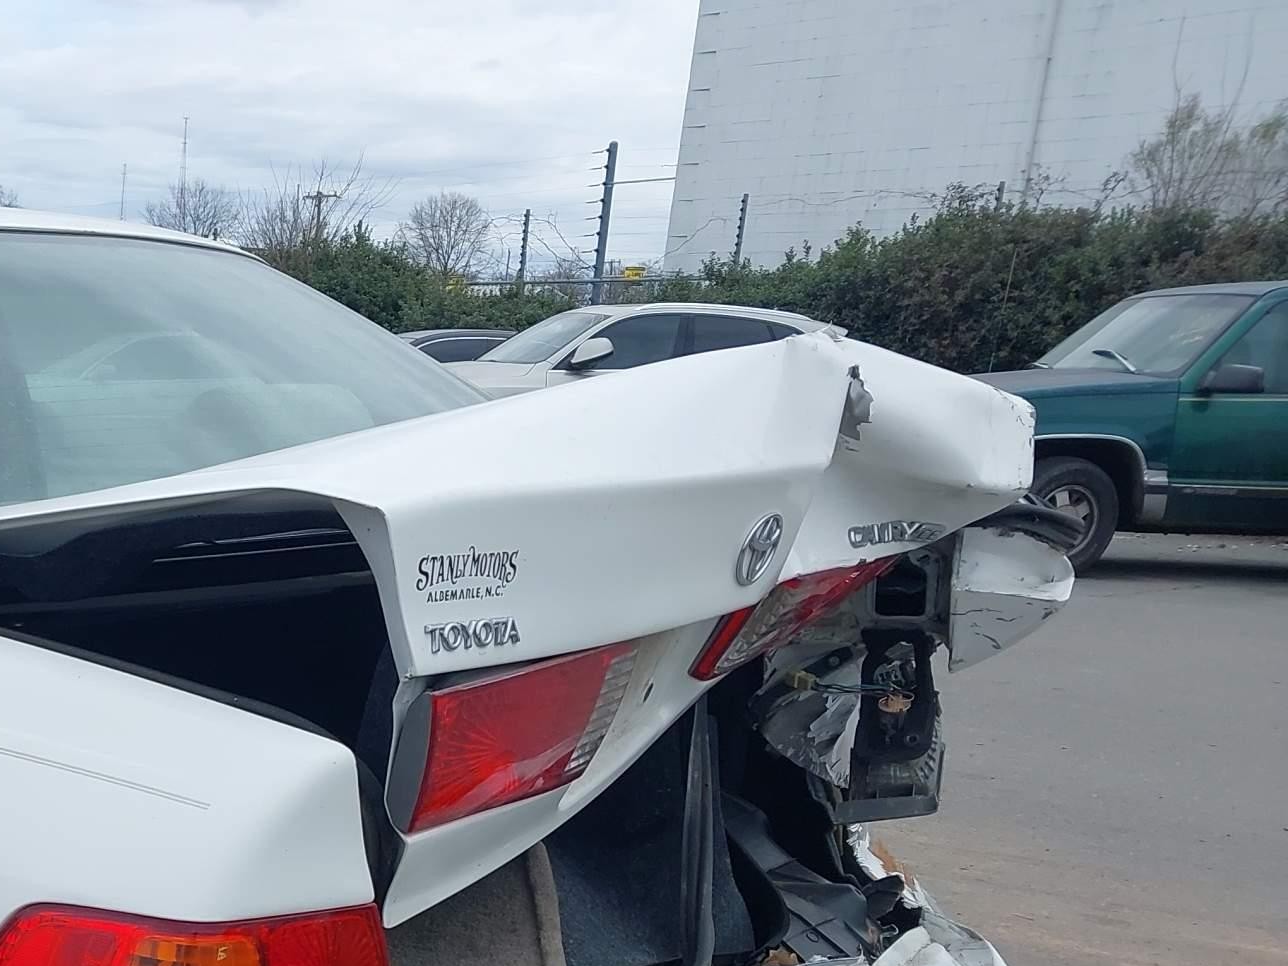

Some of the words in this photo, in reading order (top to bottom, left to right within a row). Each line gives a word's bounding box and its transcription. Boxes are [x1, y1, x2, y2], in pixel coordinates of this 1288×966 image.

[416, 554, 470, 591] STANLY
[468, 545, 520, 588] MOTORS
[484, 585, 504, 598] N.C.
[424, 617, 521, 654] TOYOTA
